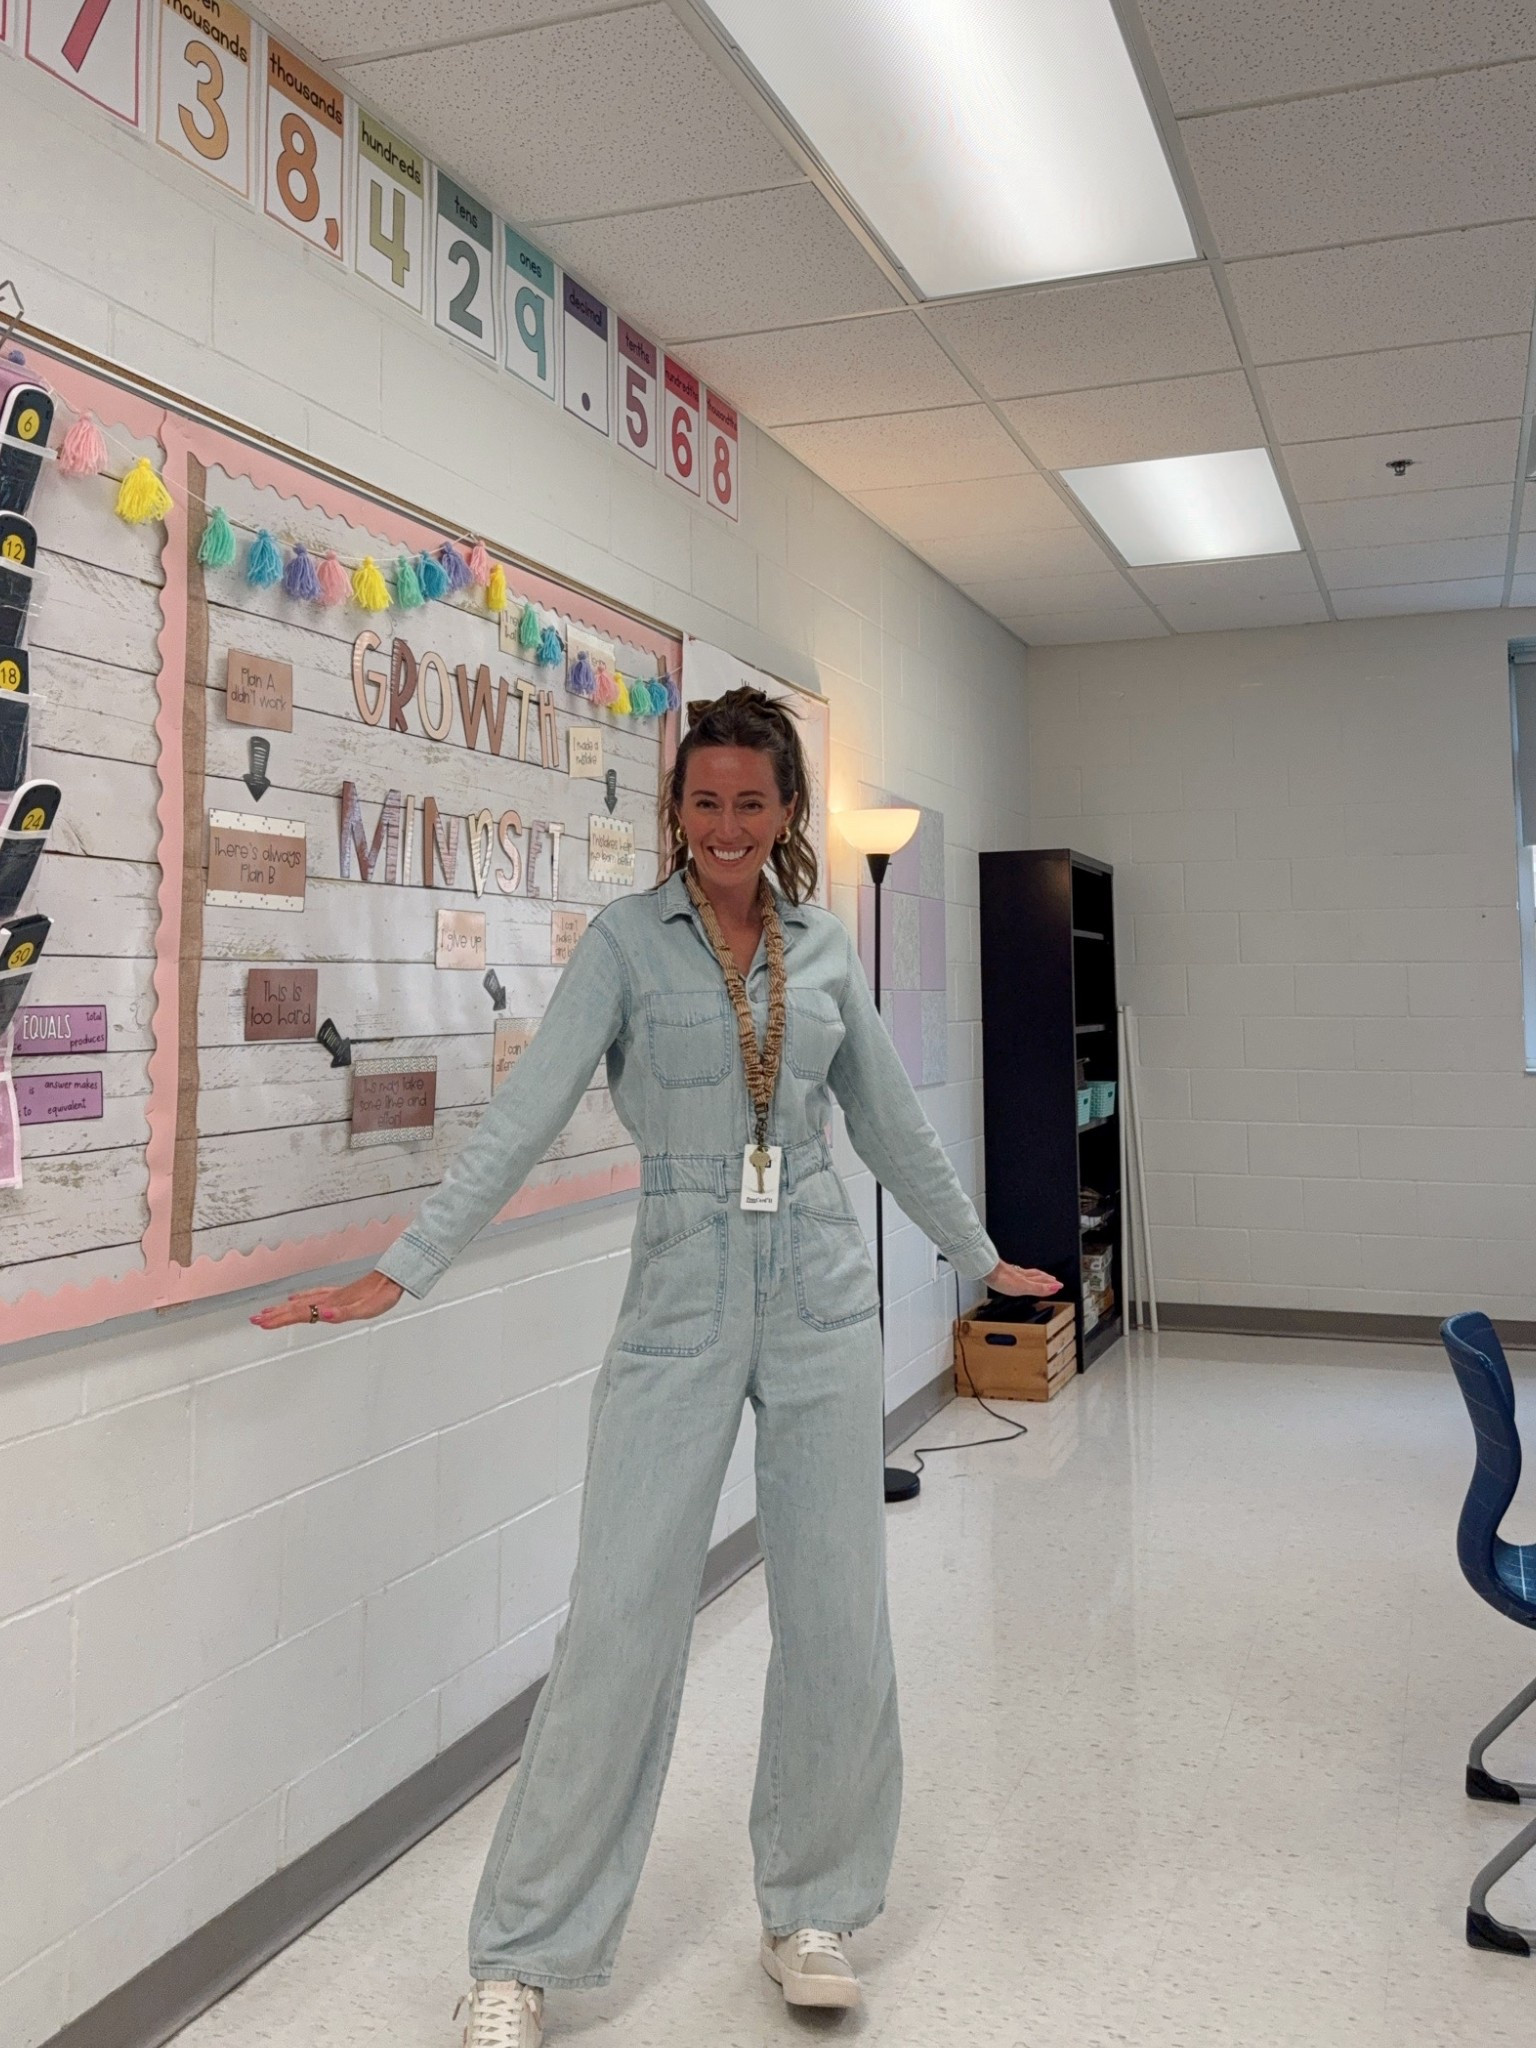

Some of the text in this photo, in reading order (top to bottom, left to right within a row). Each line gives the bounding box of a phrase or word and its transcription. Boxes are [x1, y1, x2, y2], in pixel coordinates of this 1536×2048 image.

[197, 0, 220, 17] en
[167, 0, 248, 62] housands
[178, 40, 229, 160] 3
[269, 52, 343, 125] thousands
[362, 121, 421, 184] hundreds
[455, 195, 478, 229] tens
[370, 179, 410, 288] 4
[520, 250, 542, 278] ones
[448, 240, 482, 338] 2
[569, 288, 602, 327] decimal
[515, 286, 546, 381] 9
[625, 332, 650, 364] tenths
[626, 365, 648, 448] 5
[24, 416, 33, 432] 6
[672, 406, 692, 477] 6
[713, 436, 732, 504] 8
[7, 541, 22, 560] 12
[0, 668, 17, 685] 18
[241, 667, 275, 692] Plan A
[260, 695, 287, 711] work
[352, 630, 560, 769] GROWTH
[24, 814, 42, 830] 24
[214, 837, 301, 868] There's always
[341, 781, 565, 901] MINDSET
[241, 864, 276, 884] Plan B
[447, 930, 467, 952] give
[470, 936, 482, 954] up
[11, 948, 30, 965] 30
[264, 981, 302, 1002] This is
[23, 1014, 72, 1040] EQUALS
[86, 1012, 102, 1021] total
[251, 1003, 310, 1027] too hard
[70, 1033, 105, 1051] produces
[45, 1078, 98, 1090] answer makes
[23, 1105, 32, 1116] to
[47, 1098, 87, 1118] equivalent
